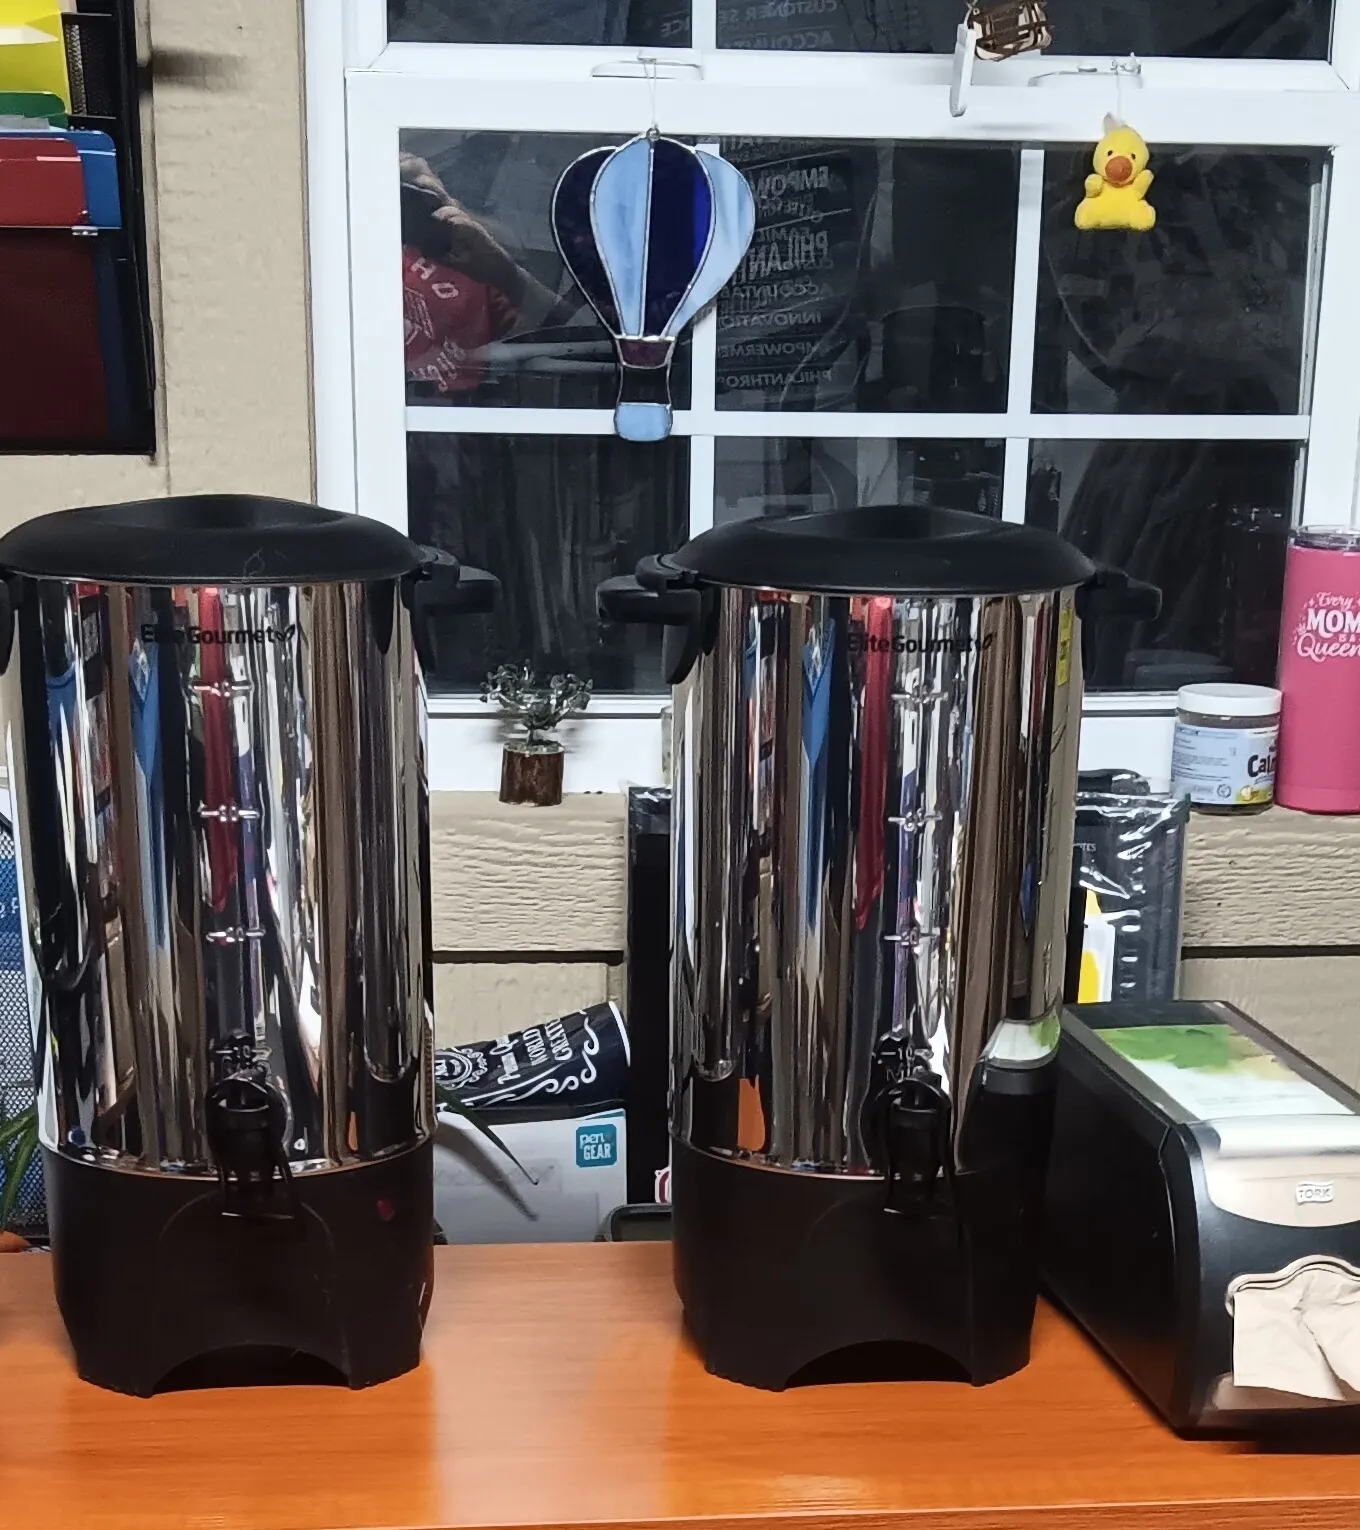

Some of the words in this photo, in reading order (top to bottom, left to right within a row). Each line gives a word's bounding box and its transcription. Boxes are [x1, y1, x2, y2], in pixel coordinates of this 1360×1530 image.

[1316, 592, 1354, 612] Every
[583, 1144, 612, 1161] GEAR
[1297, 1186, 1332, 1199] TORK
